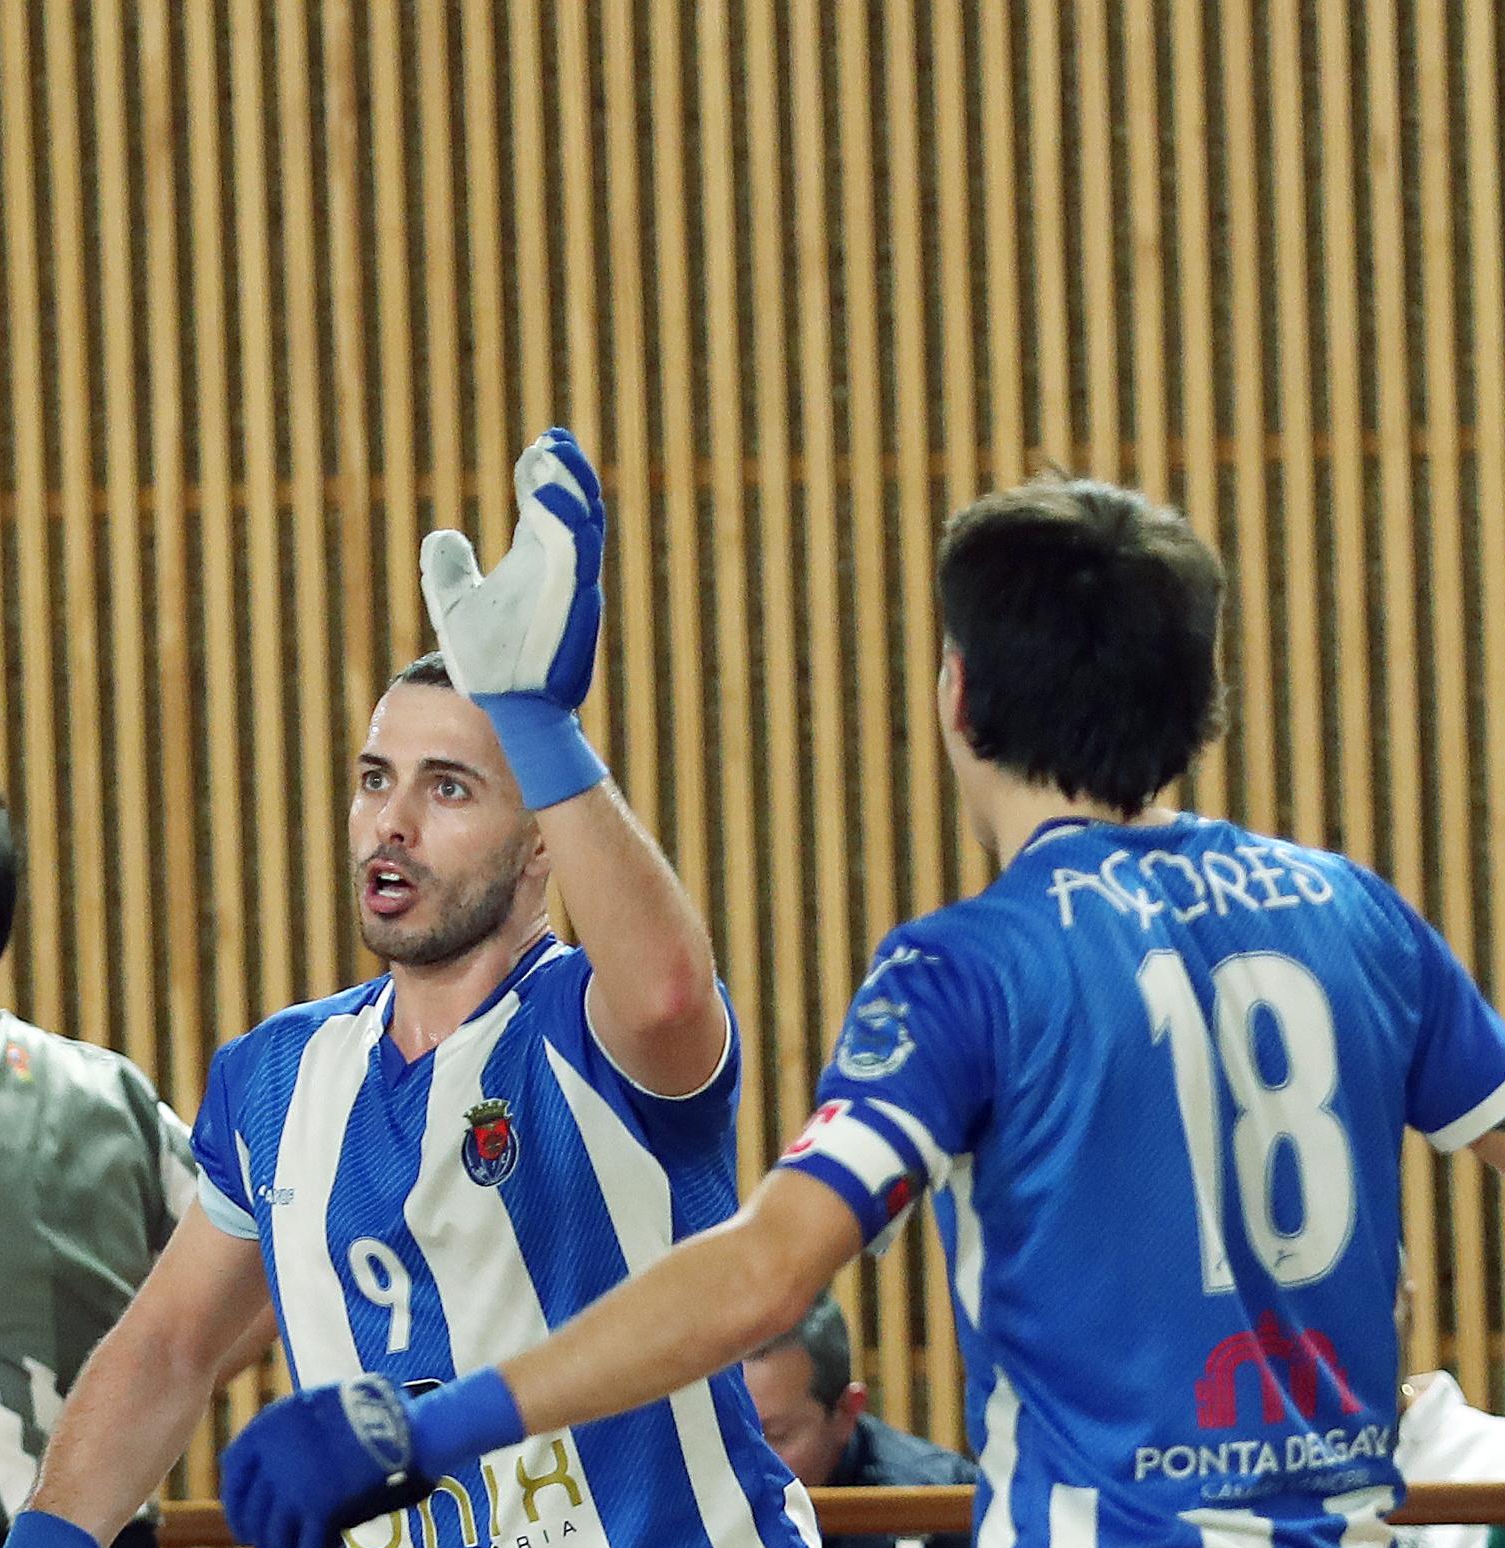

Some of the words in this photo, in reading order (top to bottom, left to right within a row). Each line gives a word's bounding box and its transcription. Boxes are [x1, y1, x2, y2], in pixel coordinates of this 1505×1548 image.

[1136, 947, 1358, 1294] 18
[347, 1236, 412, 1353] 9
[1134, 1439, 1279, 1482] PONTA
